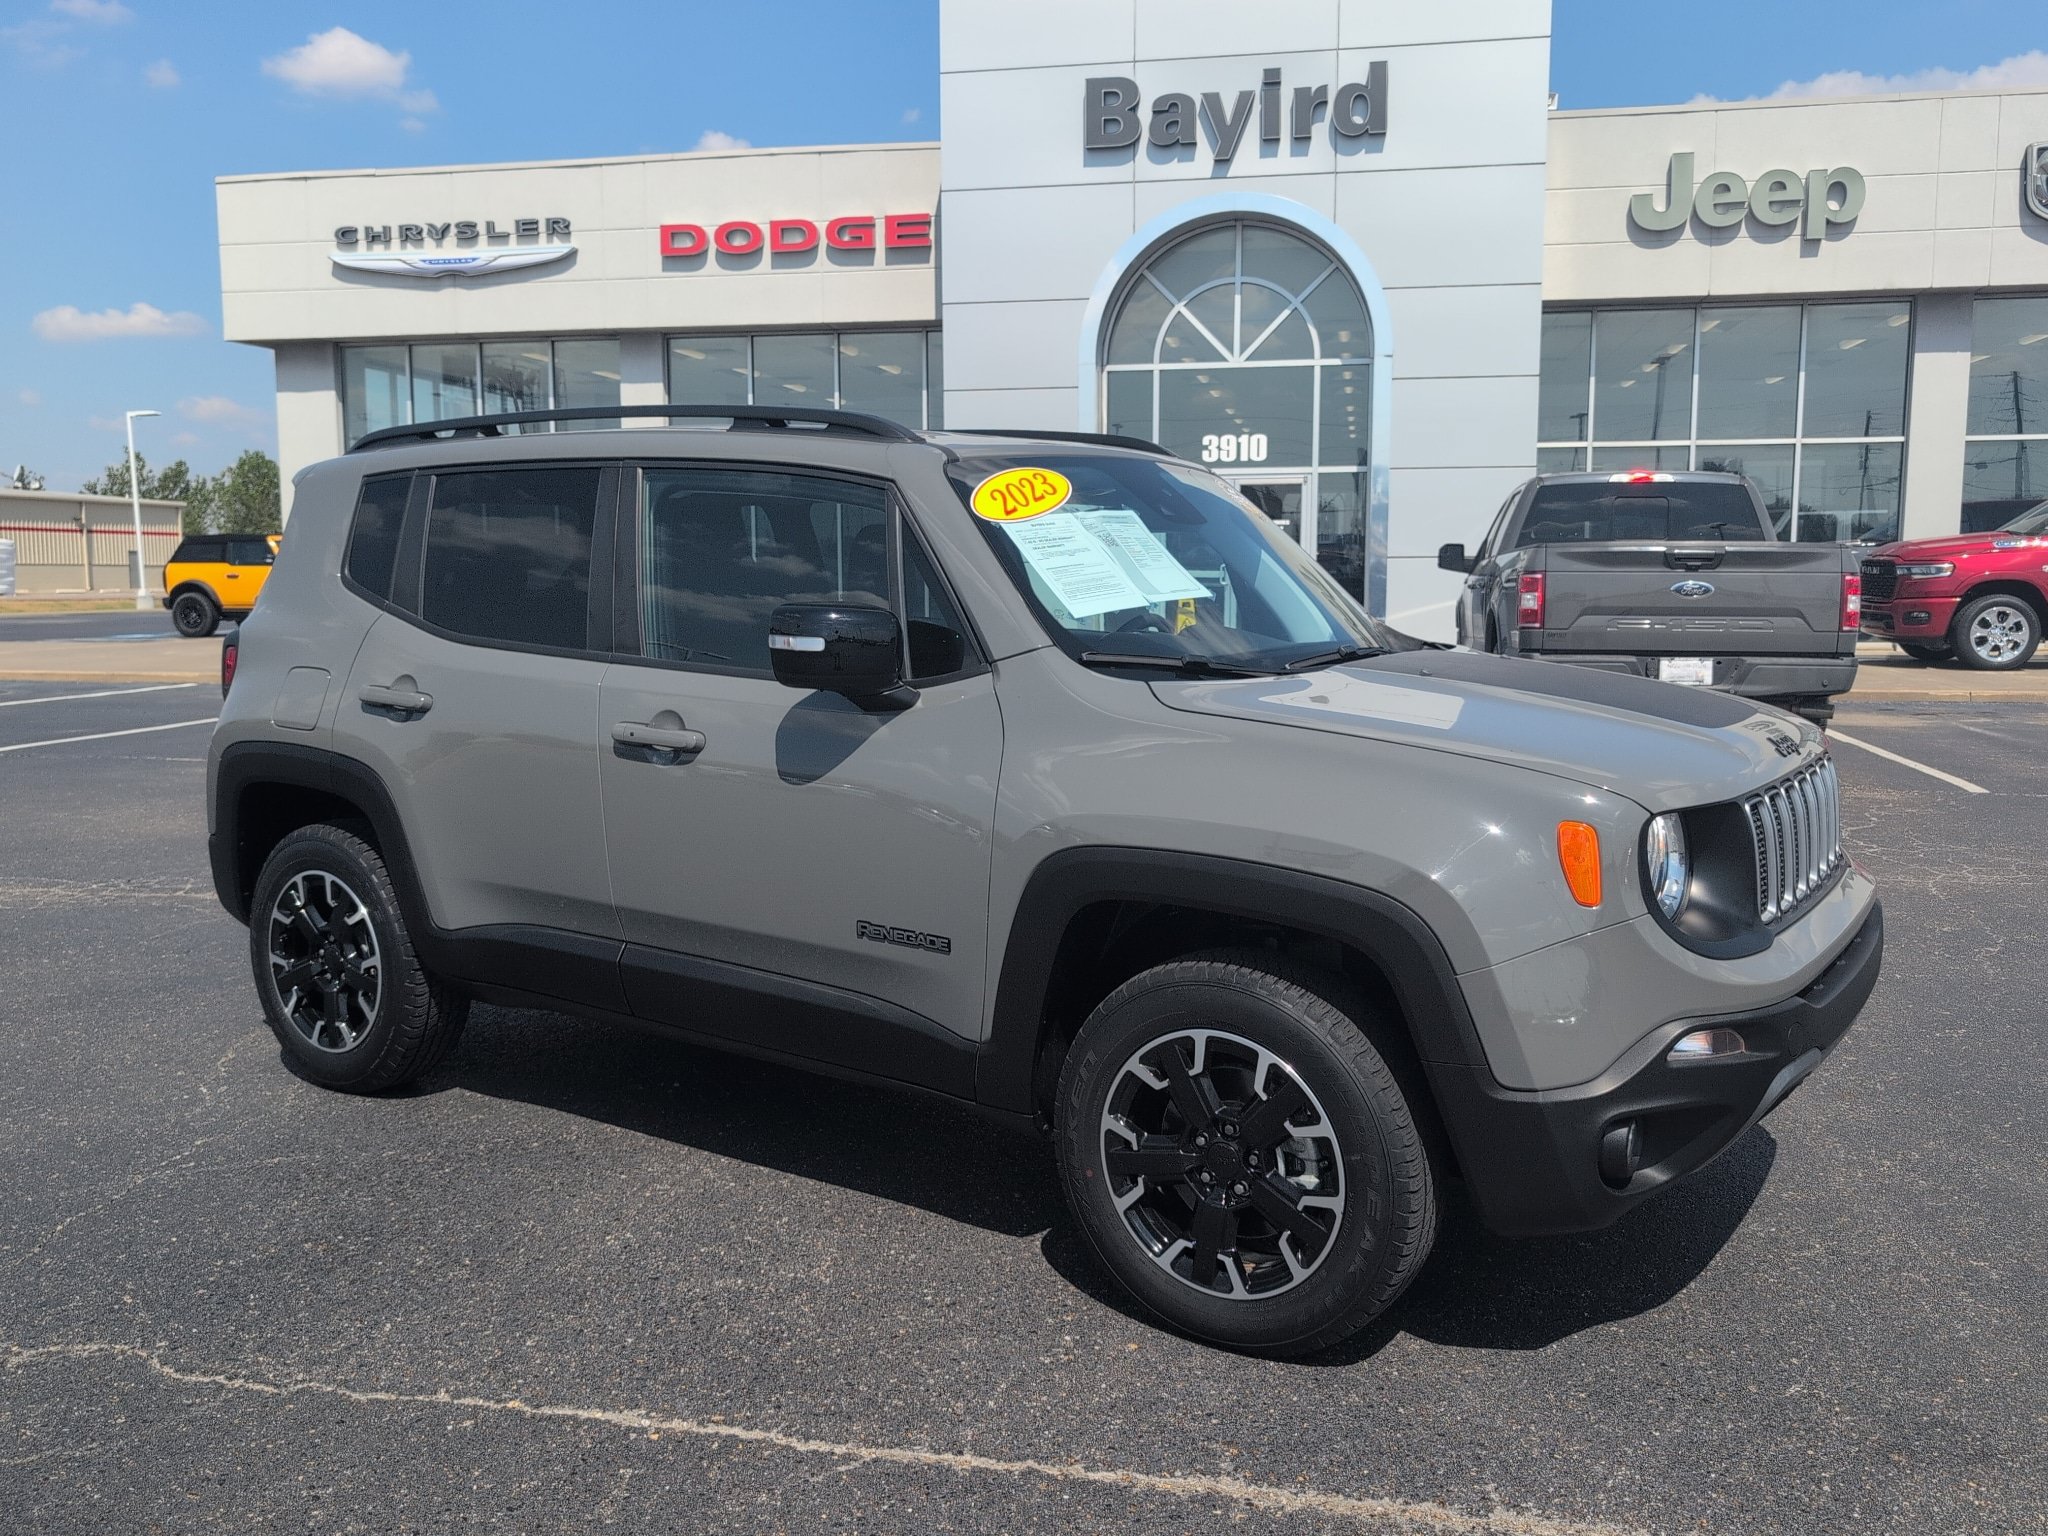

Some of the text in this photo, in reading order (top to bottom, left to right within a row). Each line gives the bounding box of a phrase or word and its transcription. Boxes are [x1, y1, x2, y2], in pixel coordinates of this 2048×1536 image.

[1085, 60, 1388, 160] Bayird
[1629, 151, 1867, 240] Jeep
[335, 217, 571, 244] CHRYSLER
[660, 213, 932, 256] DODGE
[1201, 433, 1268, 462] 3910
[990, 472, 1057, 516] 2023
[857, 920, 951, 954] RENEGADE
